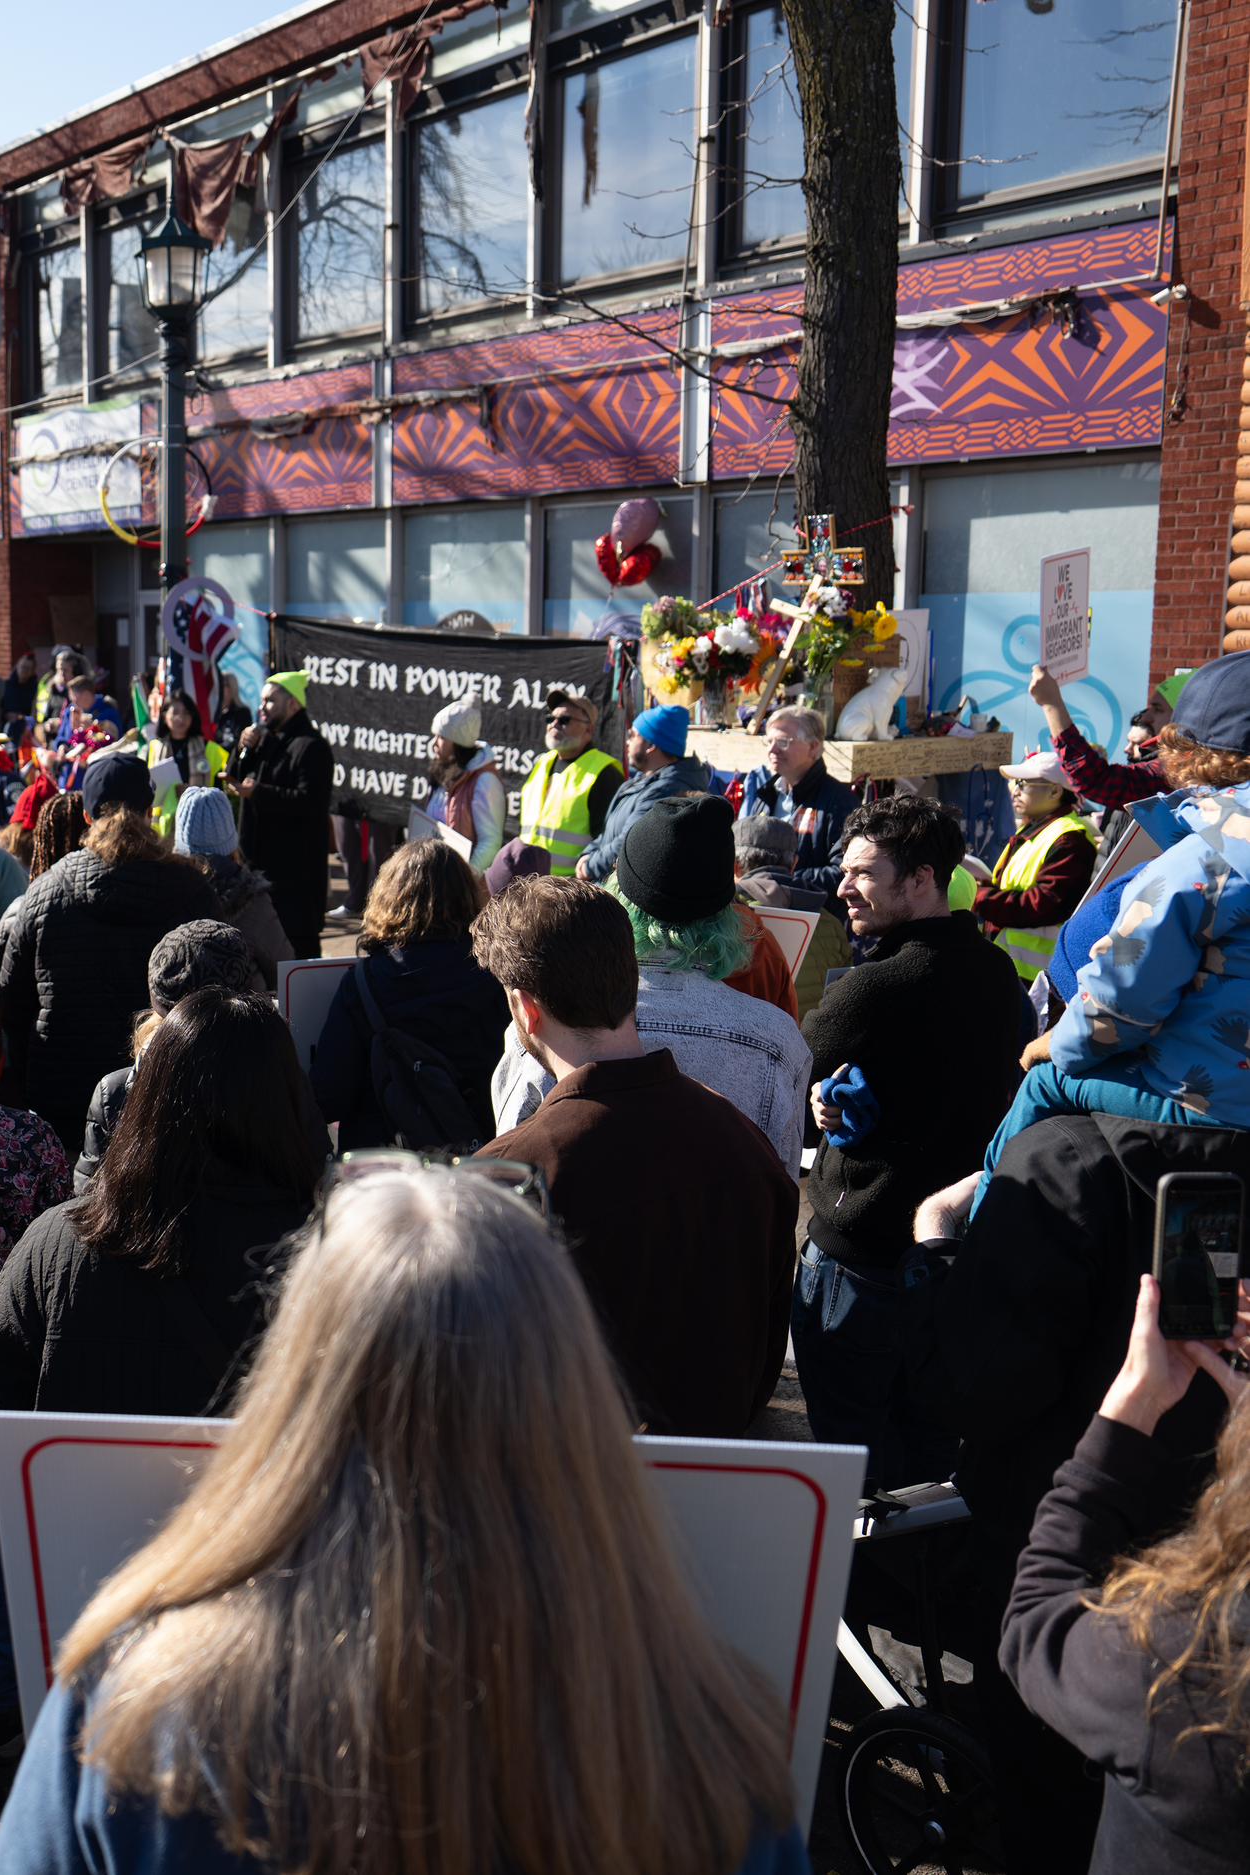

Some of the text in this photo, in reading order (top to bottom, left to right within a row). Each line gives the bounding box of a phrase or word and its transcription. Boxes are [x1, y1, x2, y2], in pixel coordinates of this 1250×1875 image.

[1058, 564, 1070, 583] WE
[1056, 603, 1070, 619] OUR
[1045, 616, 1083, 644] IMMIGRANT
[302, 654, 366, 688] REST
[368, 661, 398, 692] IN
[405, 665, 502, 704] POWER
[350, 766, 408, 797] HAVE
